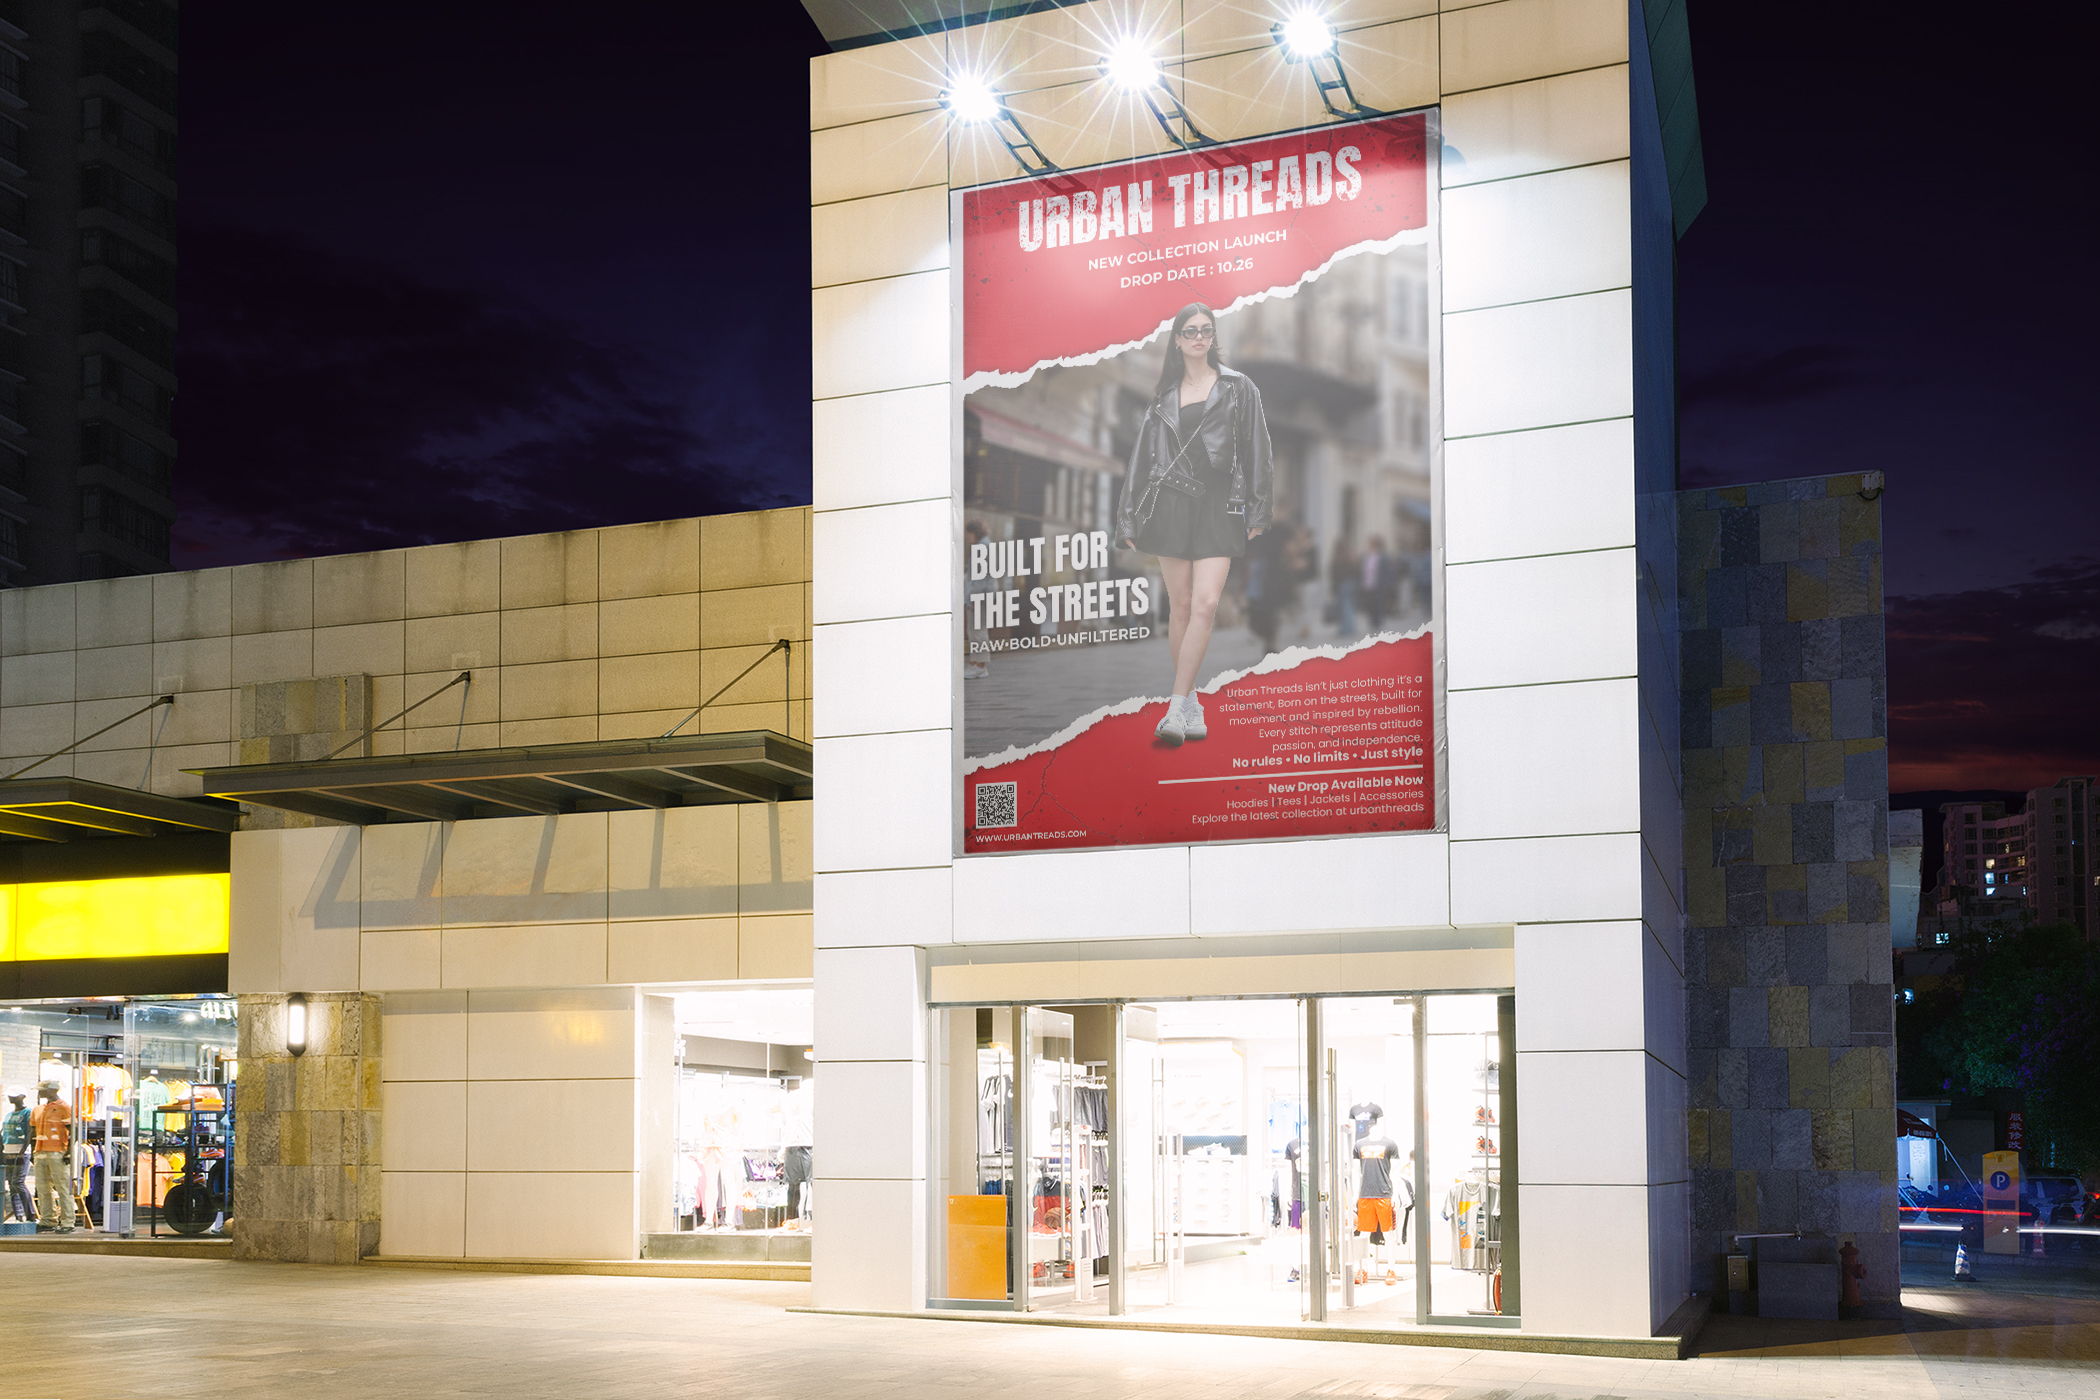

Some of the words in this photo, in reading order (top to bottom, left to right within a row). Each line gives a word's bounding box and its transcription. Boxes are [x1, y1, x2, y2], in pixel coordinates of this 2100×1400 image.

[1018, 179, 1154, 252] URBAN
[1169, 145, 1362, 228] THREADS
[1088, 254, 1124, 271] NEW
[1127, 239, 1219, 266] COLLECTION
[1224, 229, 1287, 250] LAUNCH
[1120, 271, 1163, 289] DROP
[1167, 265, 1206, 283] DATE
[1217, 257, 1254, 275] 10.26
[970, 537, 1046, 581] BUILT
[1055, 530, 1108, 573] FOR
[970, 589, 1020, 630] THE
[1029, 577, 1149, 625] STREETS
[1227, 687, 1258, 698] Urban
[1260, 683, 1303, 695] Threads
[1328, 680, 1348, 692] just
[1350, 677, 1395, 688] clothing
[1414, 675, 1423, 683] a
[1219, 700, 1275, 712] statement,
[1278, 698, 1301, 708] Born
[1304, 698, 1318, 706] on
[1320, 695, 1337, 704] the
[1340, 692, 1379, 703] streets,
[1381, 691, 1405, 700] built
[1408, 689, 1422, 699] for
[1229, 714, 1286, 726] movement
[1289, 711, 1310, 722] and
[1312, 709, 1354, 723] inspired
[1357, 707, 1371, 718] by
[1373, 704, 1423, 715] rebellion.
[1259, 728, 1286, 738] Every
[1289, 725, 1318, 736] stitch
[1320, 722, 1377, 735] represents
[1380, 718, 1423, 730] attitude
[1272, 740, 1316, 754] passion,
[1318, 738, 1340, 749] and
[1342, 734, 1424, 747] independence.
[1232, 758, 1249, 768] No
[1251, 755, 1283, 767] rules
[1293, 753, 1311, 764] No
[1313, 751, 1350, 763] limits
[1360, 749, 1389, 760] Just
[1391, 746, 1423, 759] style
[1268, 783, 1296, 794] New
[1298, 781, 1328, 793] Drop
[1331, 777, 1392, 790] Available
[1394, 776, 1423, 786] Now
[1226, 799, 1268, 809] Hoodies
[1277, 796, 1301, 806] Tees
[1309, 794, 1350, 804] Jackets
[1359, 789, 1424, 802] Accessories
[1192, 813, 1228, 826] Explore
[1231, 812, 1247, 822] the
[1250, 810, 1279, 821] latest
[1281, 808, 1333, 819] collection
[1336, 806, 1347, 816] at
[1350, 803, 1424, 815] urbanthreads
[976, 830, 1087, 842] WWW.URBANTREADS.COM
[1996, 1174, 2006, 1188] P
